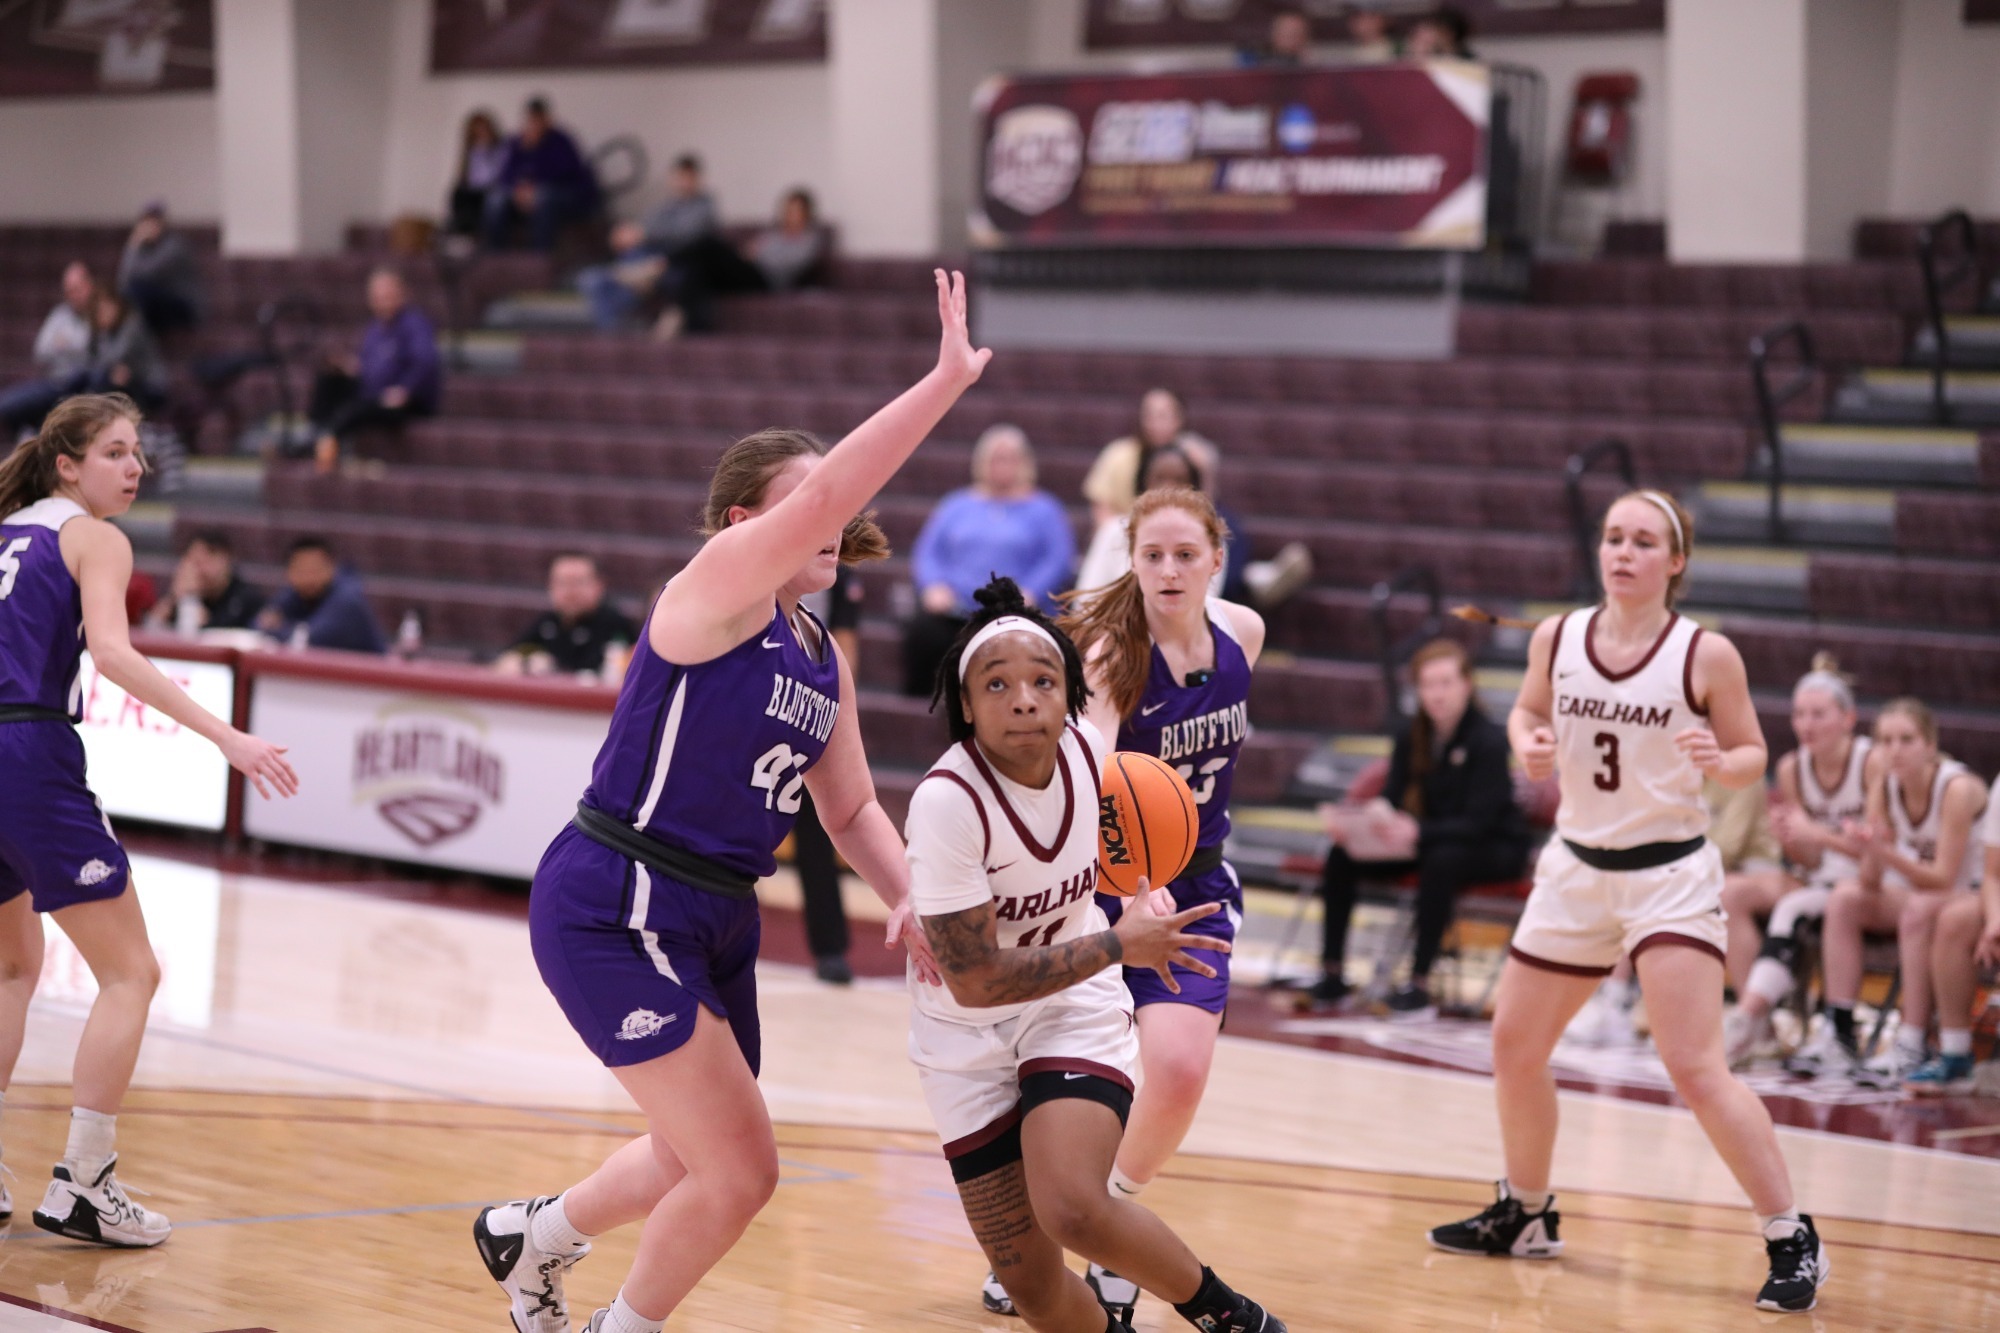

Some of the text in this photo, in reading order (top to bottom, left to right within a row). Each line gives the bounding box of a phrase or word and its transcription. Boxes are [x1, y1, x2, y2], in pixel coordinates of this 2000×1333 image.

[765, 673, 839, 743] BLUFFTON
[1559, 695, 1673, 728] EARLHAM
[354, 728, 506, 806] HEARTLAND
[750, 743, 809, 814] 42
[1594, 731, 1621, 793] 3
[1099, 794, 1131, 865] NCAA
[993, 858, 1098, 921] ARLHA
